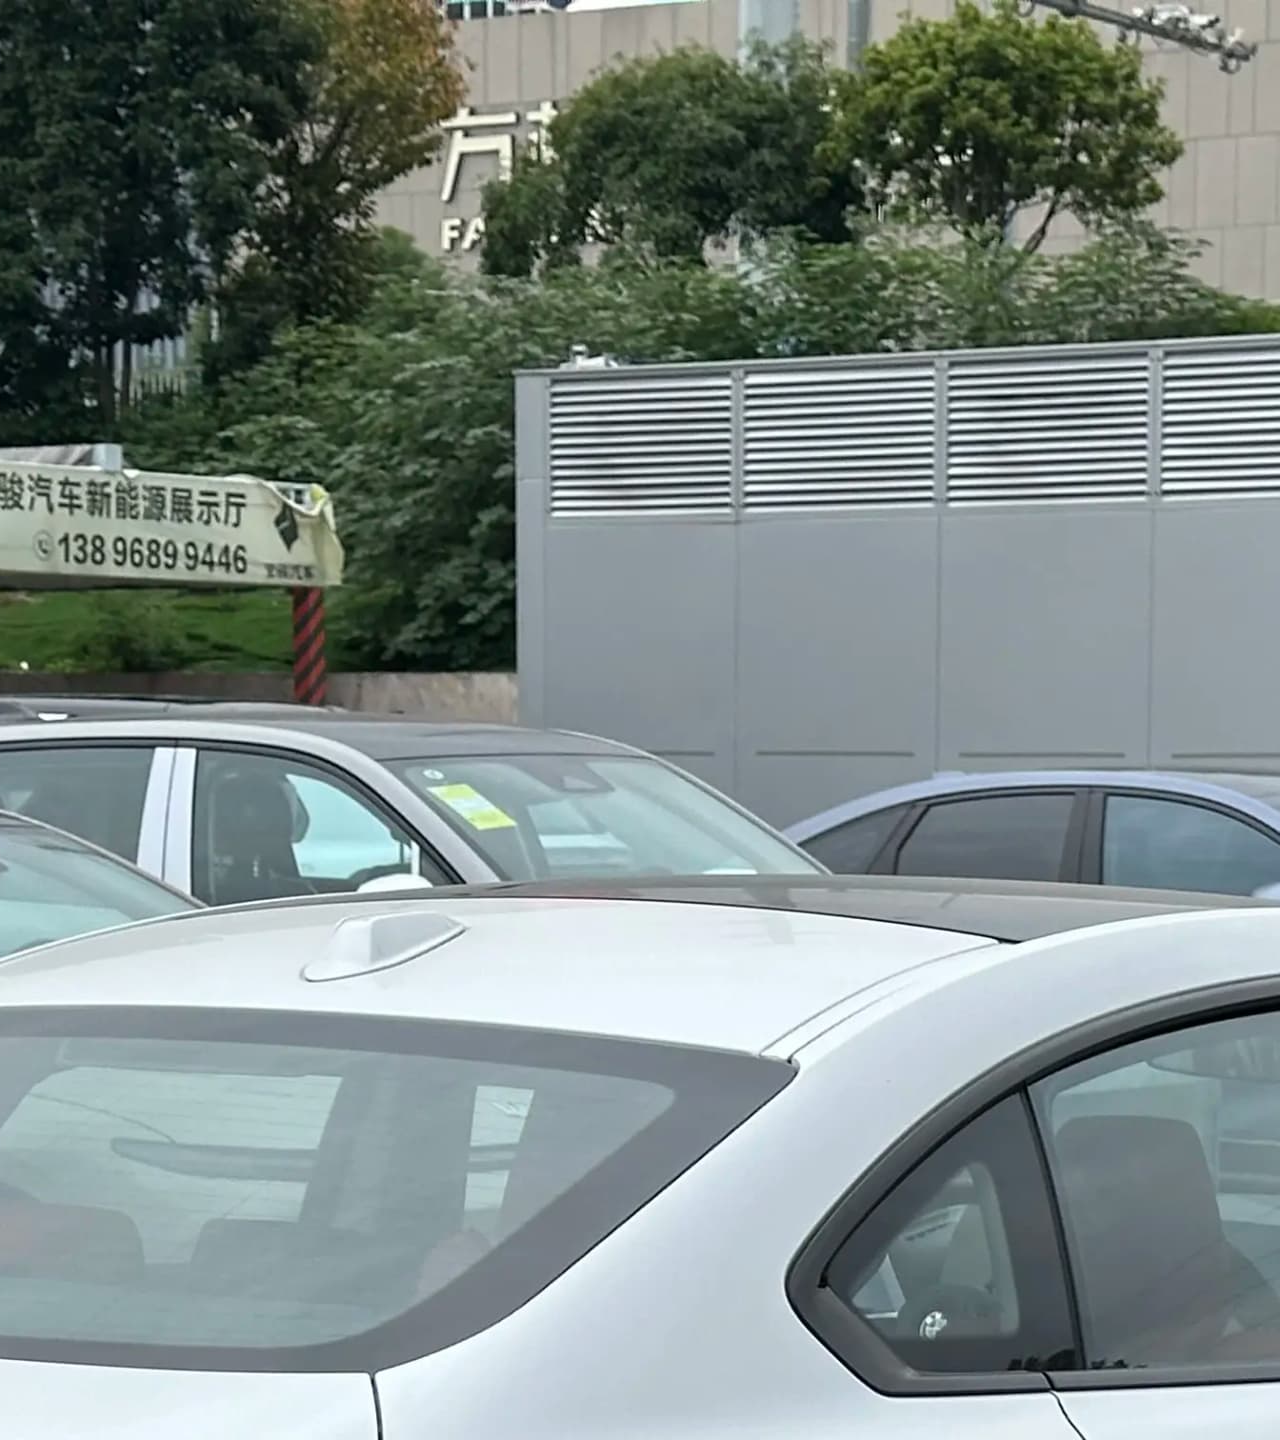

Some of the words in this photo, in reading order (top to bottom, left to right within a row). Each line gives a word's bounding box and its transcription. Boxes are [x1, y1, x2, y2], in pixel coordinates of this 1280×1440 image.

[58, 532, 107, 566] 138
[112, 536, 179, 570] 9689
[184, 540, 248, 575] 9446
